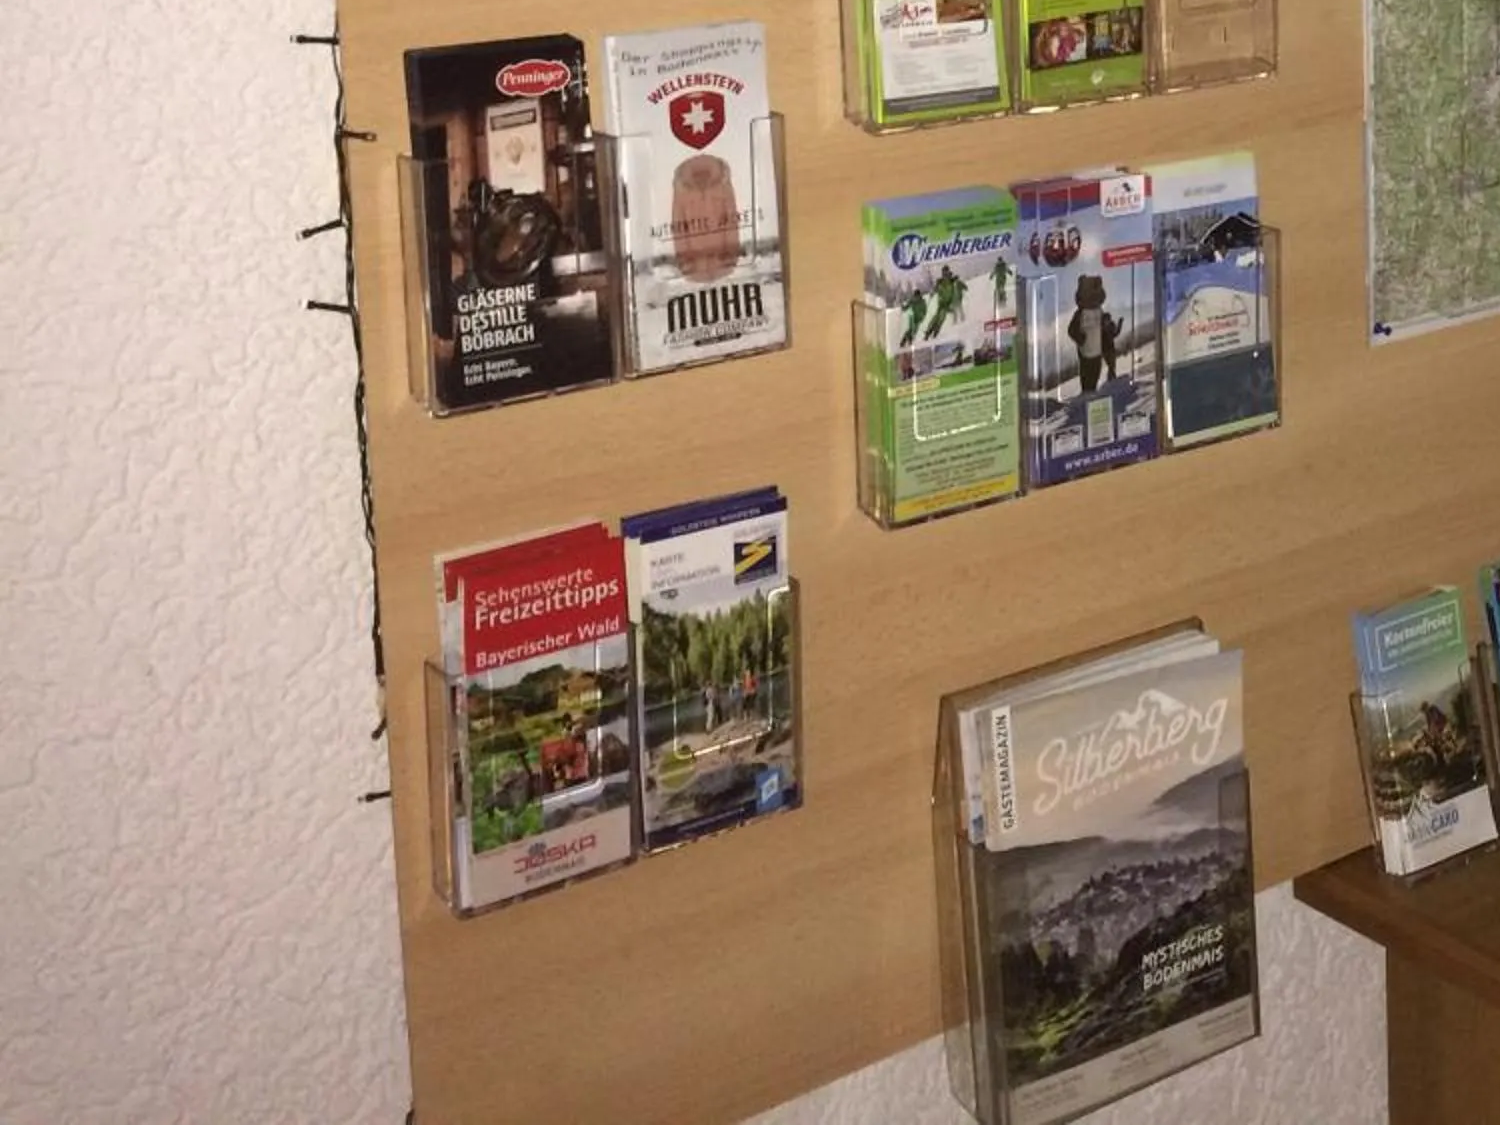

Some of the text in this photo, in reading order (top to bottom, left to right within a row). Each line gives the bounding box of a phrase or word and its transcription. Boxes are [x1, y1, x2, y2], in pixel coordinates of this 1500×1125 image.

[502, 69, 565, 87] Penninger
[647, 71, 745, 105] WELLENSTEYN
[457, 283, 537, 313] GLÄSERNE
[460, 305, 528, 334] DESTILLE
[666, 282, 763, 334] MUHR
[461, 323, 535, 353] BÖBRACH
[475, 567, 593, 607] Sehenswerte
[475, 578, 620, 631] Freizeittipps
[475, 614, 620, 669] Bayerischer Wald
[995, 714, 1015, 830] GÄSTEMAGAZIN
[1033, 692, 1229, 815] Silberberg
[1141, 924, 1224, 971] MYSTISCHES
[1143, 944, 1225, 991] BODENMAIS
